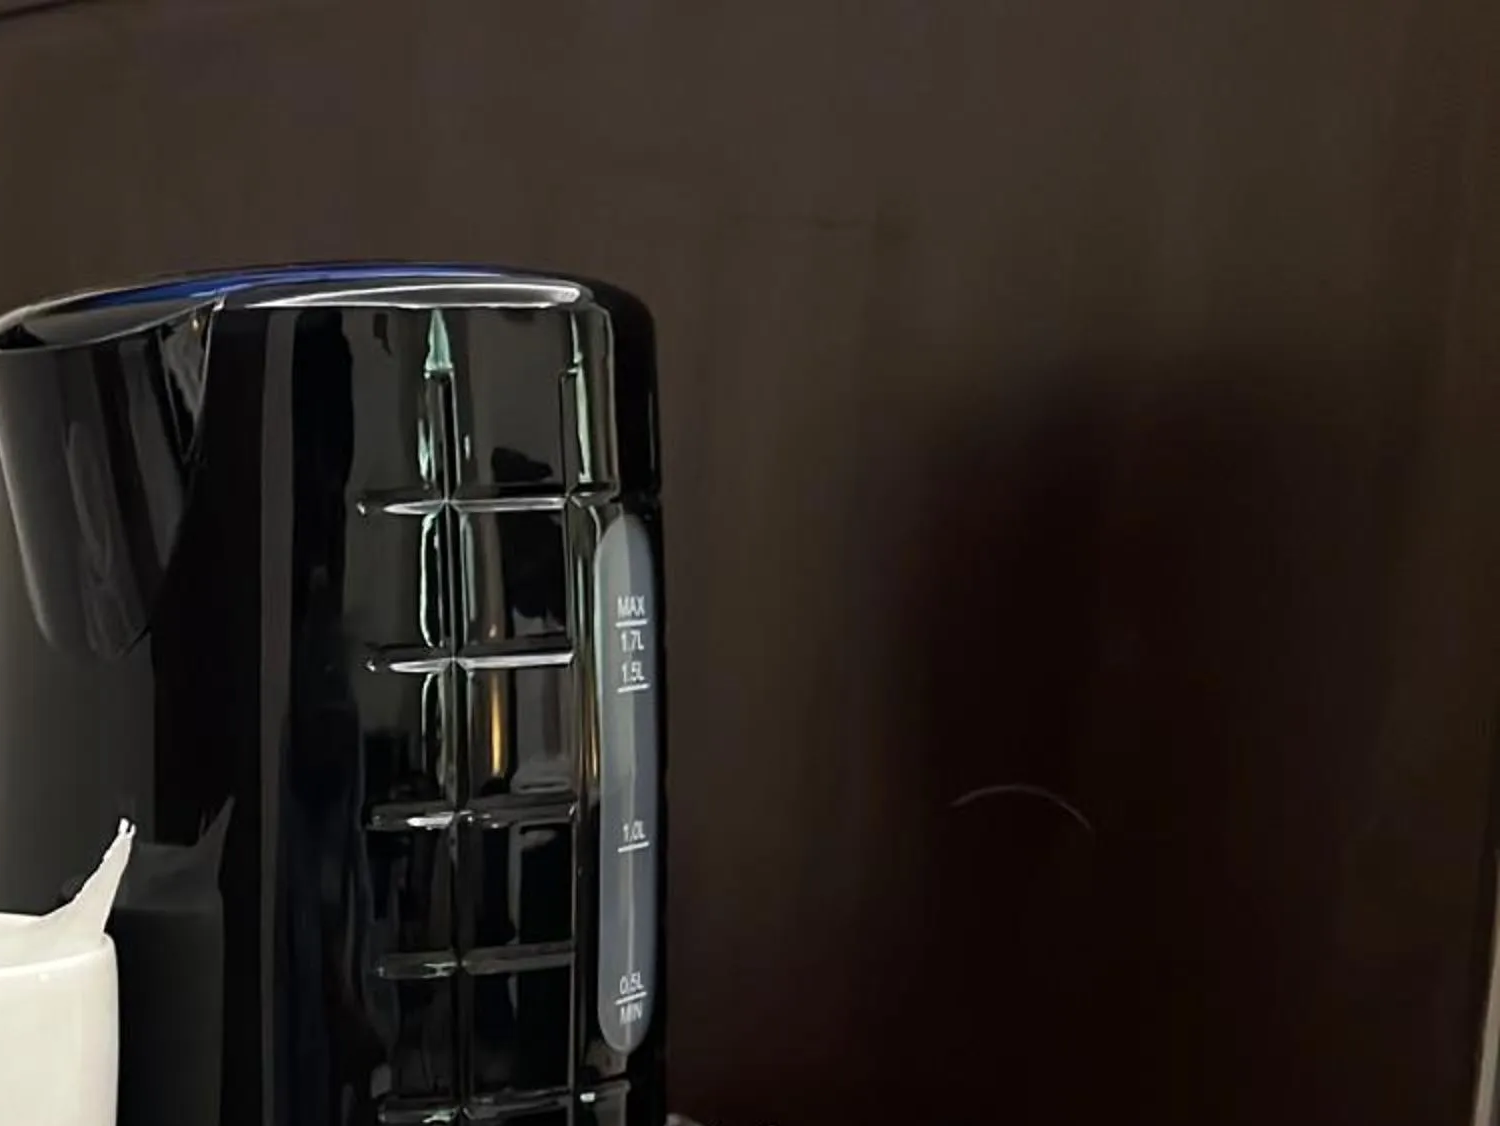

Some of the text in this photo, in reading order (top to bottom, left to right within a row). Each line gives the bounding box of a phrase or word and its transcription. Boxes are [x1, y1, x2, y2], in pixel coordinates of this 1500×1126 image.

[617, 595, 646, 619] MAX
[622, 820, 646, 842] 1.0L
[619, 972, 644, 995] 0.5L
[619, 1003, 644, 1025] MIN
